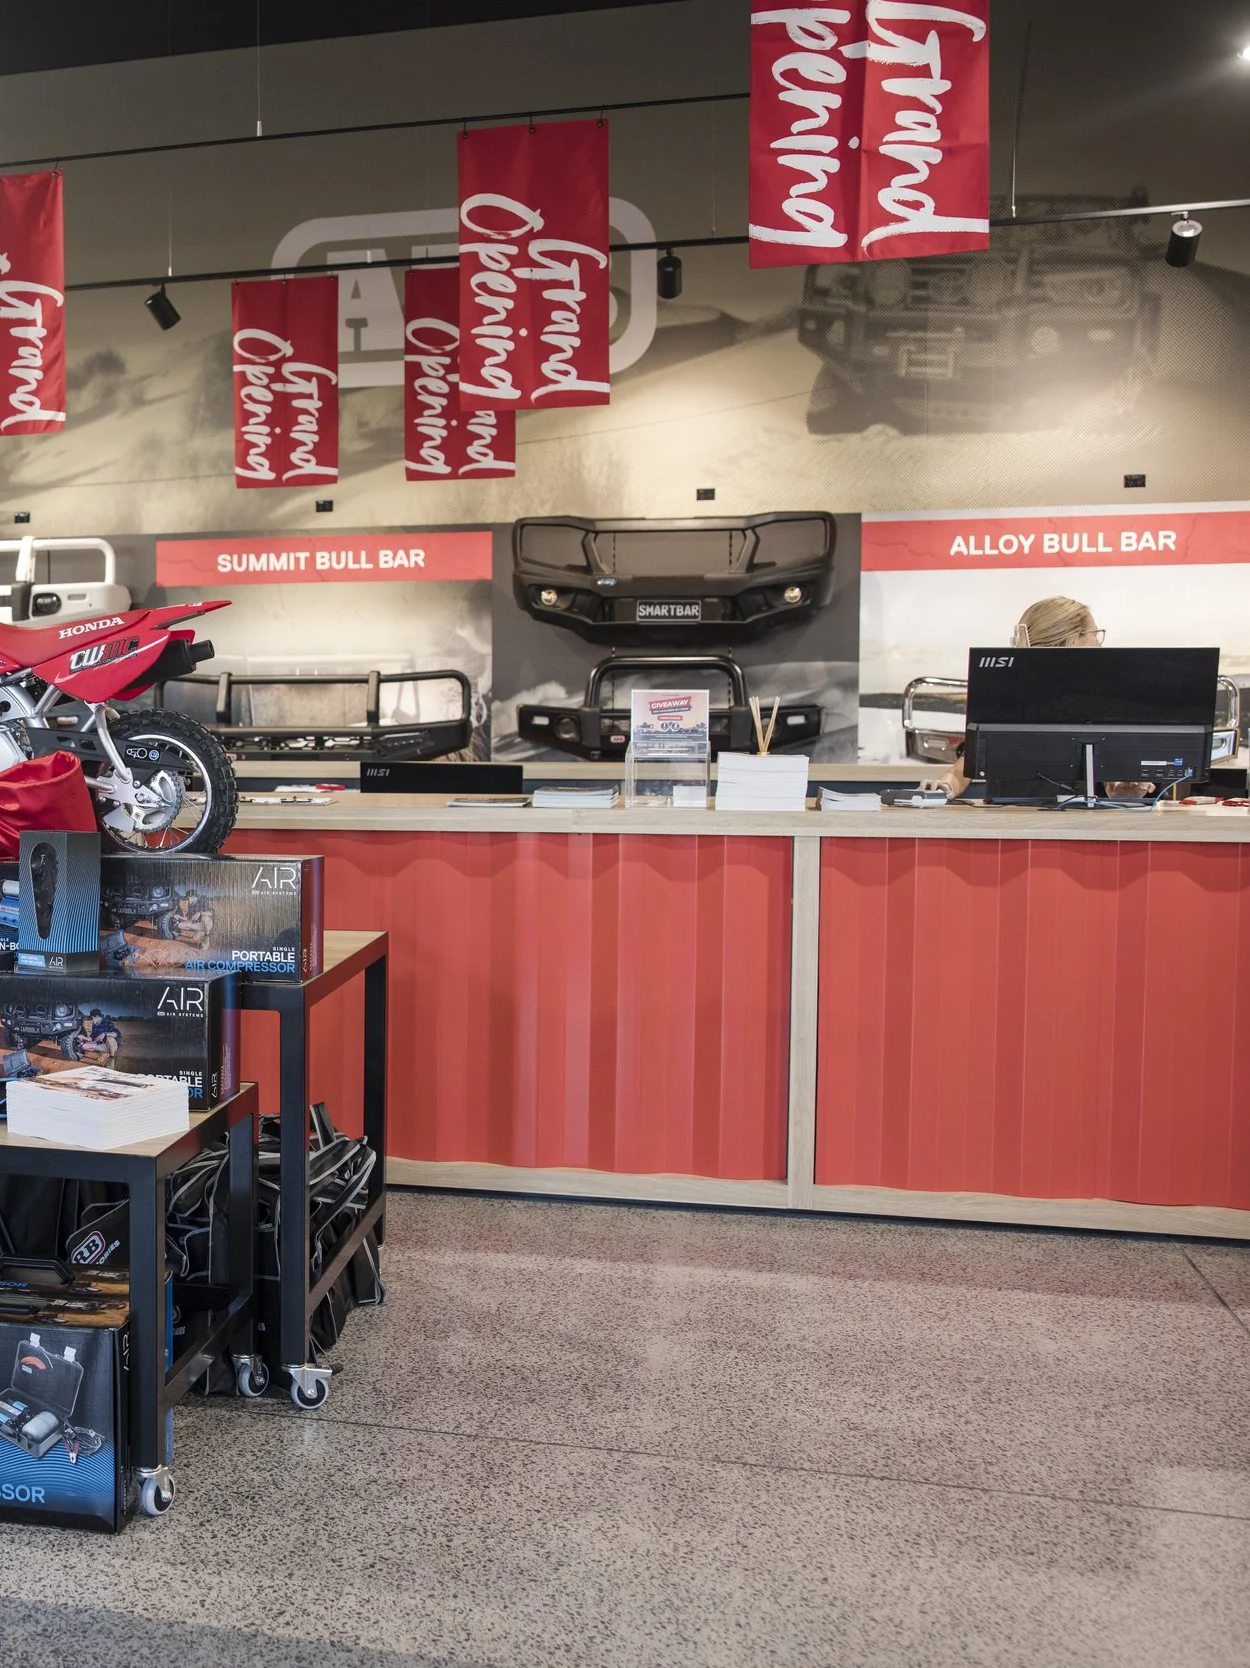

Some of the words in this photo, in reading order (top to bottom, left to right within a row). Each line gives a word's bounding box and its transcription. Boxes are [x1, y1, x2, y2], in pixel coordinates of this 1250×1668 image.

[749, 7, 860, 247] pening
[838, 1, 989, 258] Grand
[459, 193, 545, 399] Opening
[512, 239, 610, 402] Grand
[232, 328, 294, 481] Opening
[404, 318, 461, 475] Opening
[269, 362, 338, 483] Grand
[458, 409, 516, 477] and
[949, 534, 1035, 556] ALLOY
[1043, 532, 1112, 554] BULL
[1120, 530, 1177, 552] BAR
[217, 552, 310, 573] SUMMIT
[315, 550, 373, 570] BULL
[379, 548, 426, 569] BAR
[639, 604, 699, 616] SMARTBAR
[59, 617, 125, 639] HONDA
[651, 699, 689, 709] GIVEAWAY
[252, 866, 297, 889] AIR
[186, 960, 205, 970] AIR
[207, 960, 296, 973] COMPRESSOR
[232, 950, 296, 963] PORTABLE
[157, 986, 204, 1012] AIR
